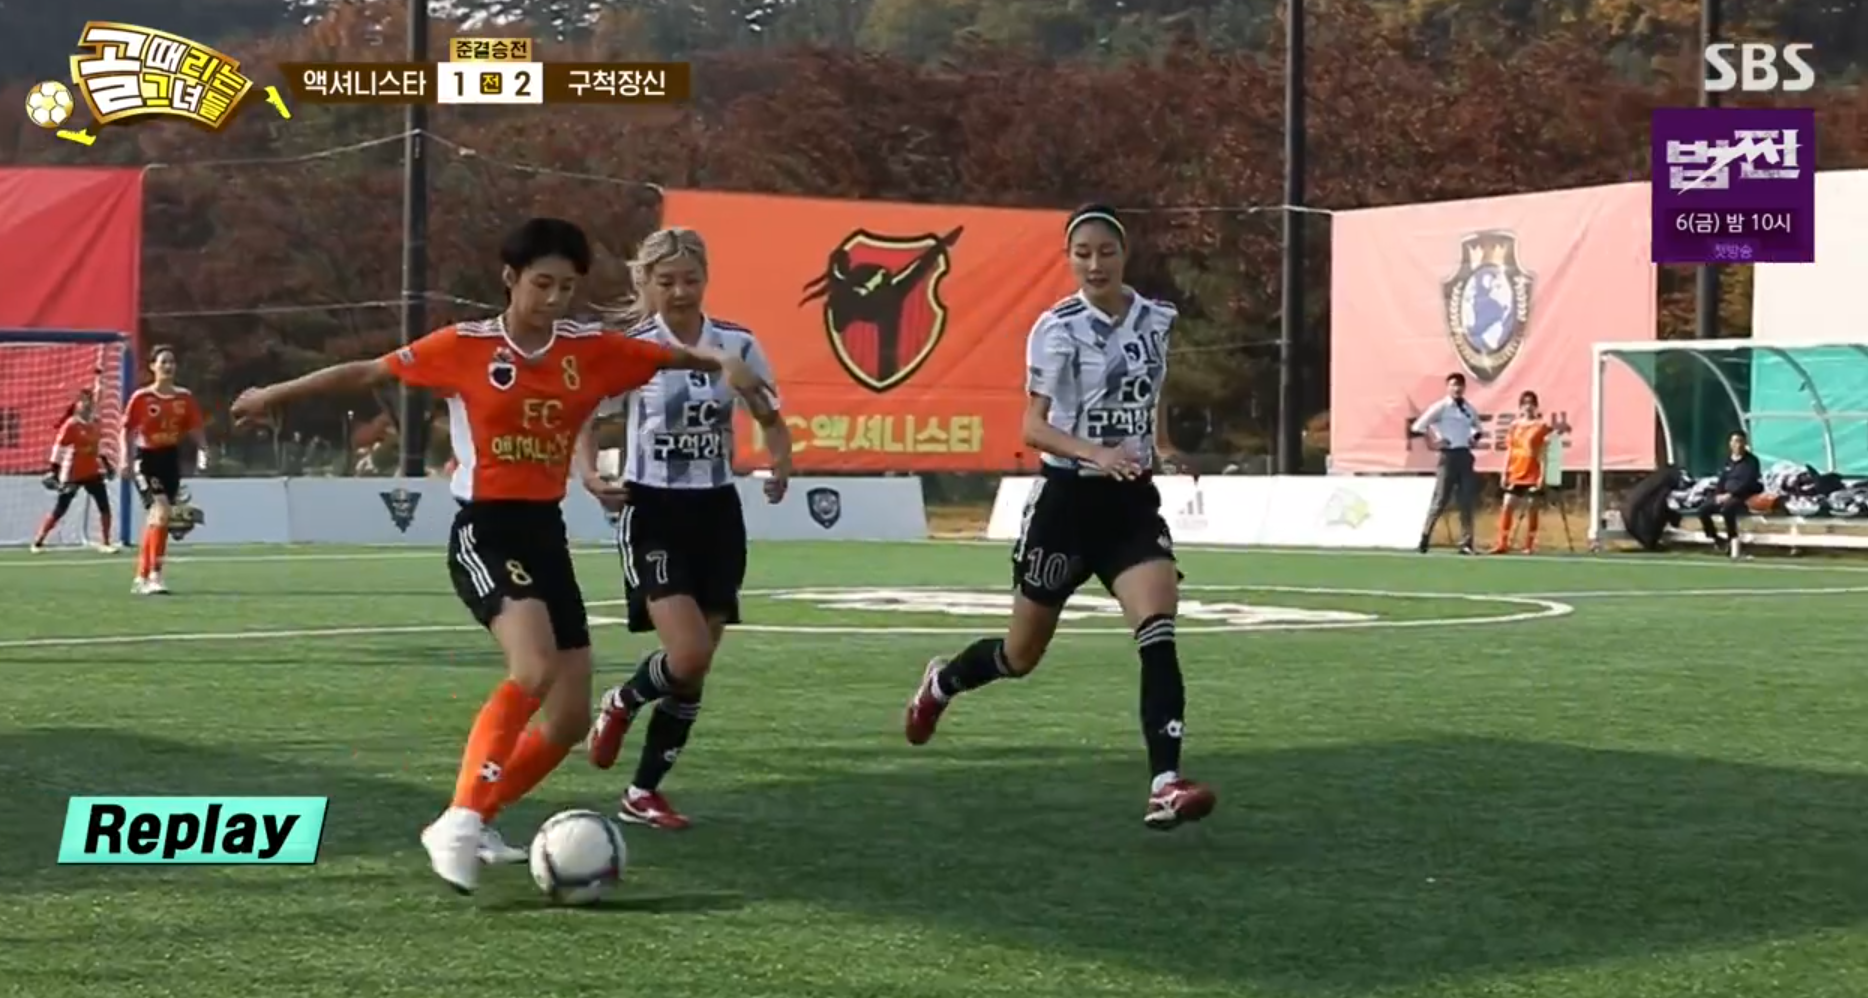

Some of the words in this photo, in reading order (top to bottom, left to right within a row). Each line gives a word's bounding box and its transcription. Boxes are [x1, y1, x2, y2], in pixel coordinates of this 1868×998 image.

[561, 355, 581, 391] 8
[1118, 375, 1151, 402] FC
[522, 398, 563, 430] FC
[682, 400, 721, 426] FC
[1088, 408, 1154, 436] 구척장
[654, 433, 724, 459] 구척장
[505, 559, 533, 587] 8
[645, 549, 670, 585] 7
[1024, 546, 1070, 590] 10
